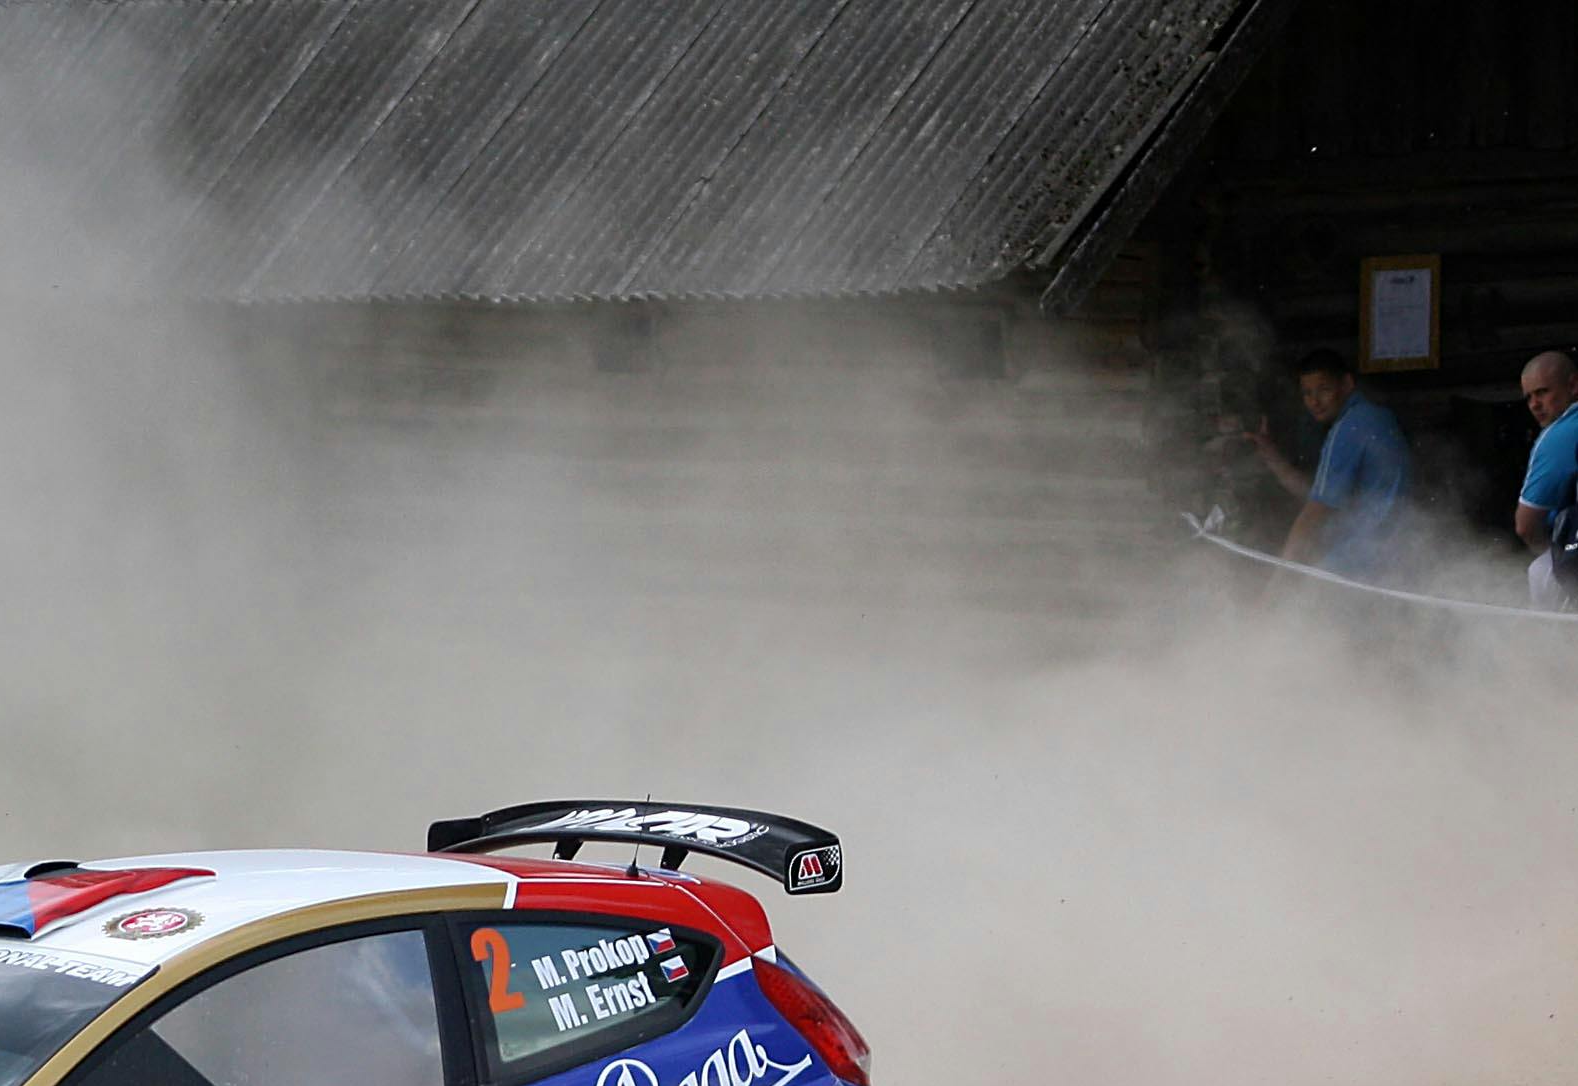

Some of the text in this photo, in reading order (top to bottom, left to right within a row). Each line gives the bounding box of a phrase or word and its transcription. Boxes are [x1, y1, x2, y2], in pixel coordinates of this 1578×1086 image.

[470, 927, 525, 1014] 2
[531, 934, 650, 990] M. Prokop
[548, 971, 656, 1032] M. Ernst
